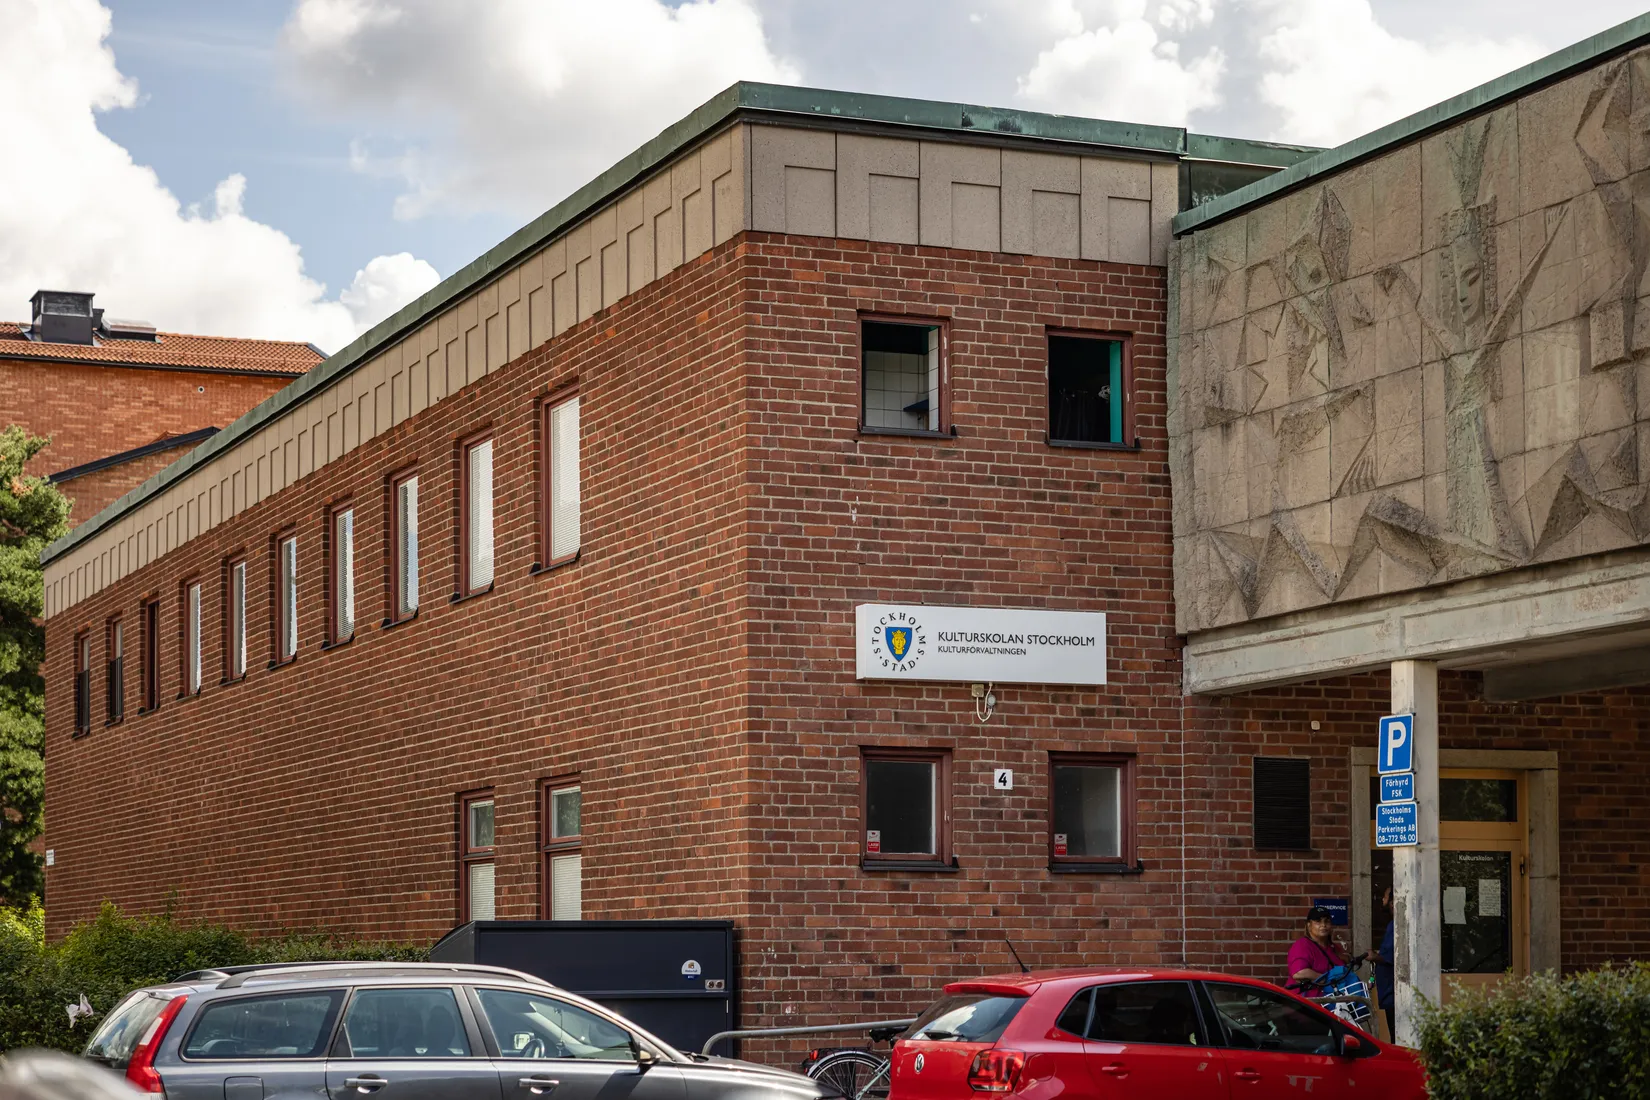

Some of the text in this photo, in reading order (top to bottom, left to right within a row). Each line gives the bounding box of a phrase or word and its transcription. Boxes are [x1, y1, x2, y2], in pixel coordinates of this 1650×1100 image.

[871, 612, 926, 656] STOCKHOLMS
[938, 631, 1095, 646] KULTURSKOLAN STOCKHOLM
[882, 659, 916, 672] STAD
[1387, 721, 1407, 767] P
[998, 772, 1007, 786] 4
[1385, 777, 1409, 788] Förhyrd
[1391, 789, 1403, 798] FSK
[1381, 806, 1411, 815] Stockholms
[1389, 815, 1404, 824] Stads
[1378, 823, 1416, 834] Parkerings AB
[1378, 833, 1416, 843] 08-772 96 00
